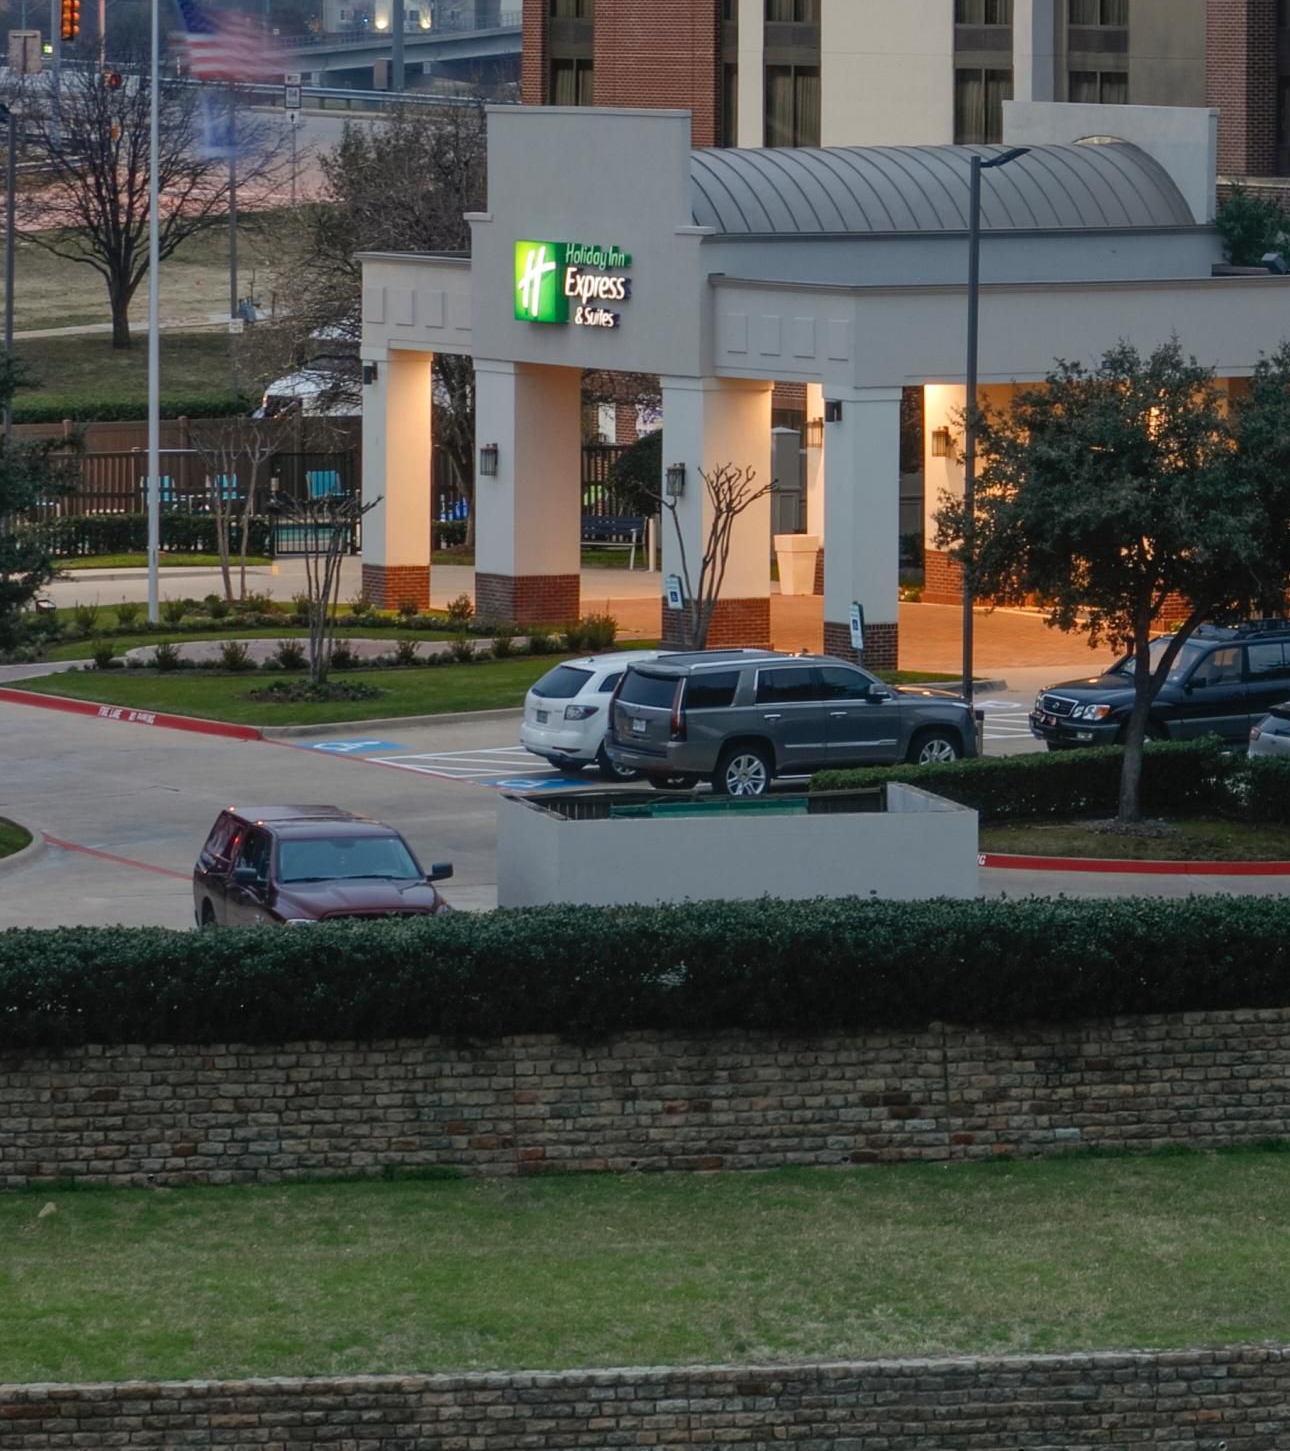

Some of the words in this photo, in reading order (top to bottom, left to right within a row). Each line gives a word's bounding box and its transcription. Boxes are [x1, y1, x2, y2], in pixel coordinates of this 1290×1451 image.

[565, 242, 608, 270] Holiday
[608, 245, 625, 267] Inn
[564, 267, 626, 305] Express
[574, 306, 584, 325] &
[584, 306, 615, 327] Suites
